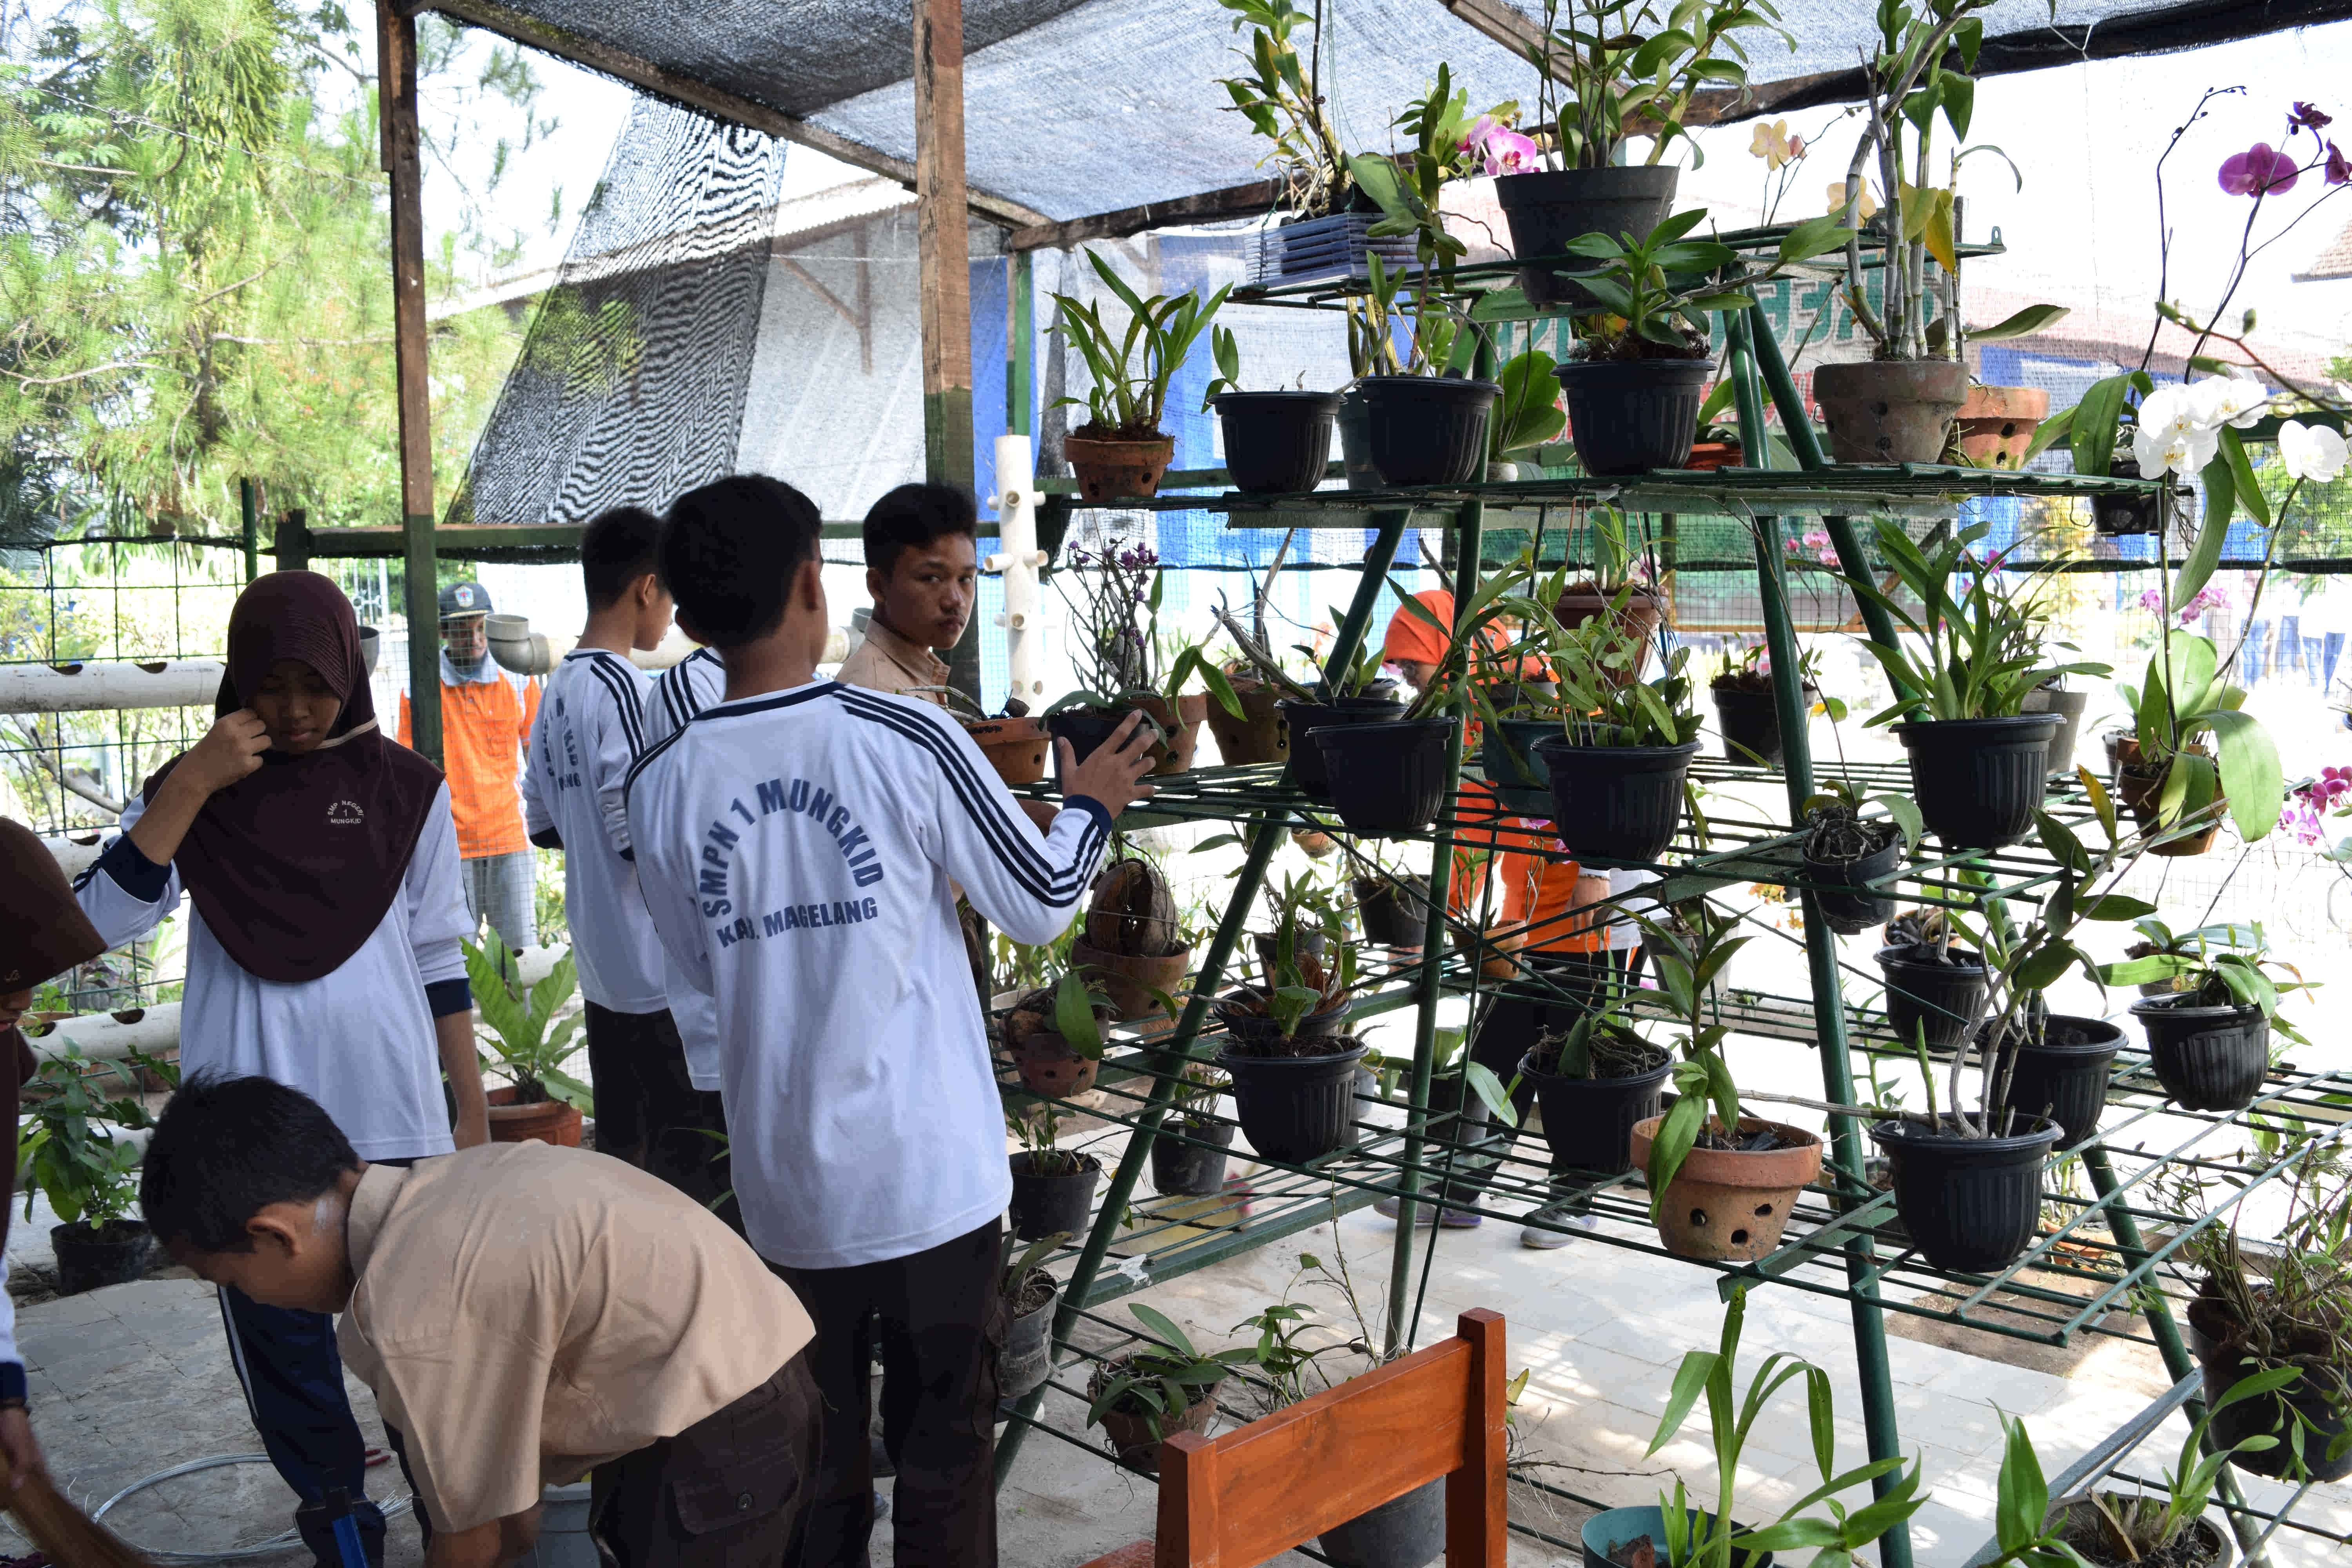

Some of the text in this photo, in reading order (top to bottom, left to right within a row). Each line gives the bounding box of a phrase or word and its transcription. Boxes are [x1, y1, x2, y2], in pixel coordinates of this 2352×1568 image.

[327, 800, 364, 816] SMP NEGERI
[699, 778, 884, 918] SMPN 1 MUNGKID
[763, 897, 878, 938] MAGELANG
